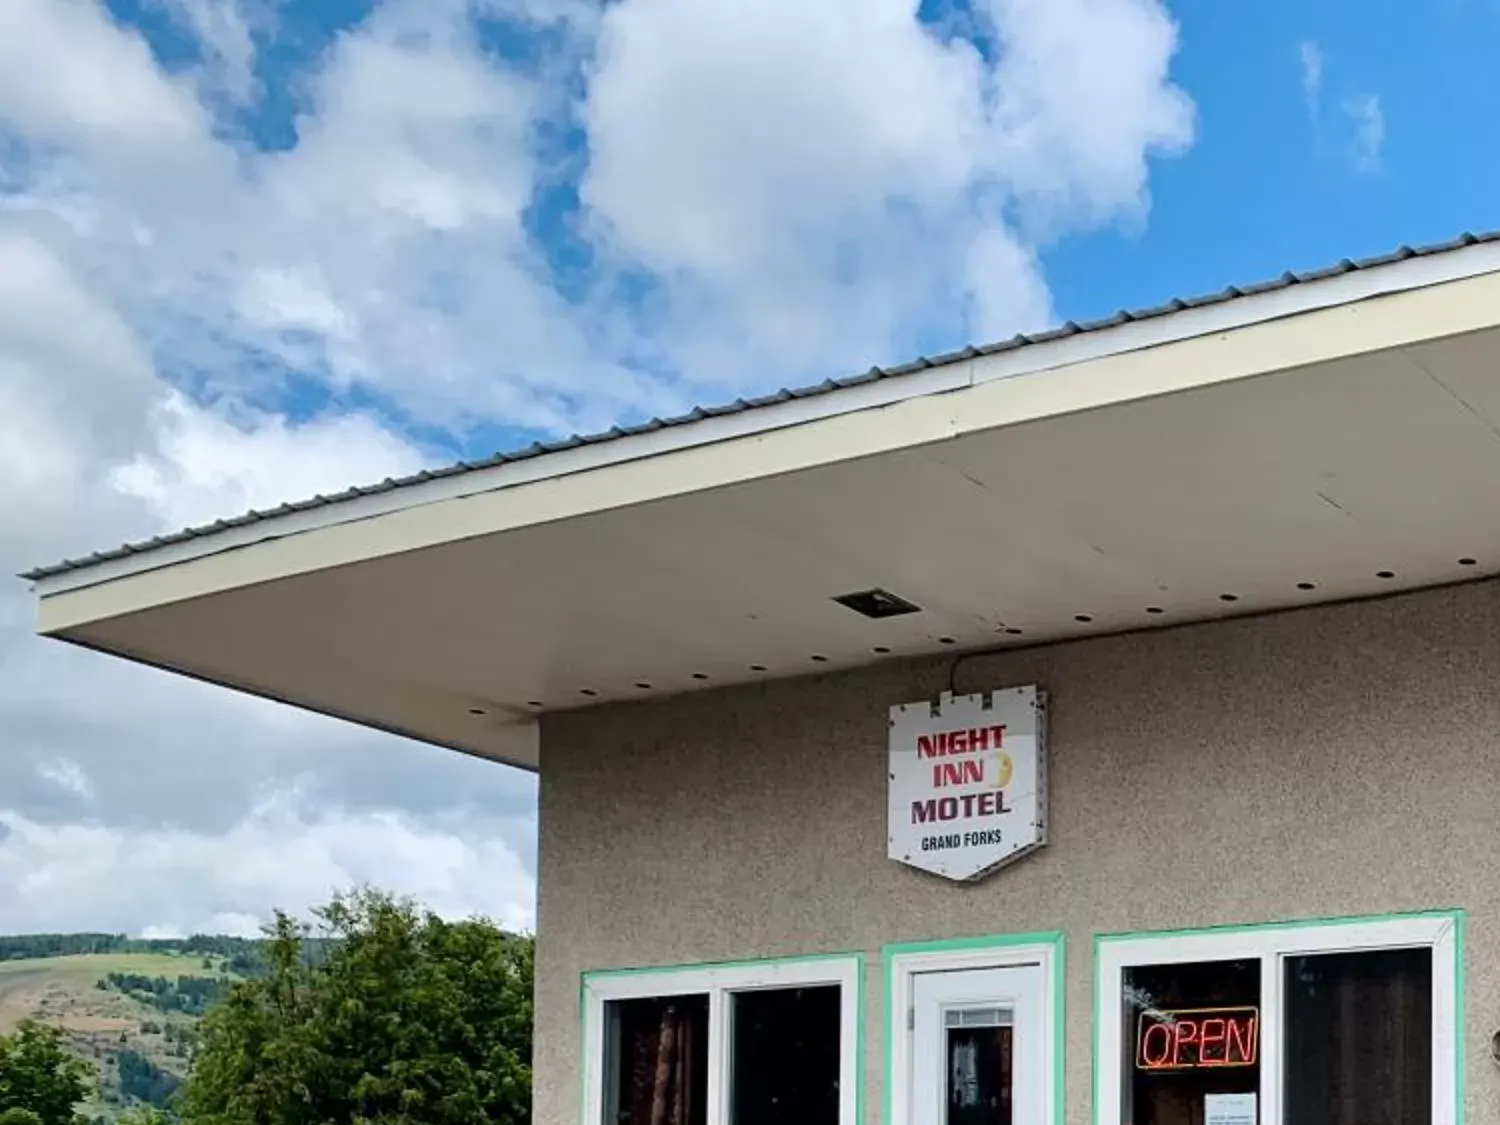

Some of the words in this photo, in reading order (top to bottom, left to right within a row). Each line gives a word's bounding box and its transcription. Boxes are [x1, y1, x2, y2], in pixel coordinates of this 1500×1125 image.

[917, 724, 1007, 759] NIGHT
[932, 758, 984, 788] INN
[911, 790, 1012, 825] MOTEL
[921, 834, 961, 851] GRAND
[963, 829, 1003, 847] FORKS
[1143, 1017, 1254, 1066] OPEN
